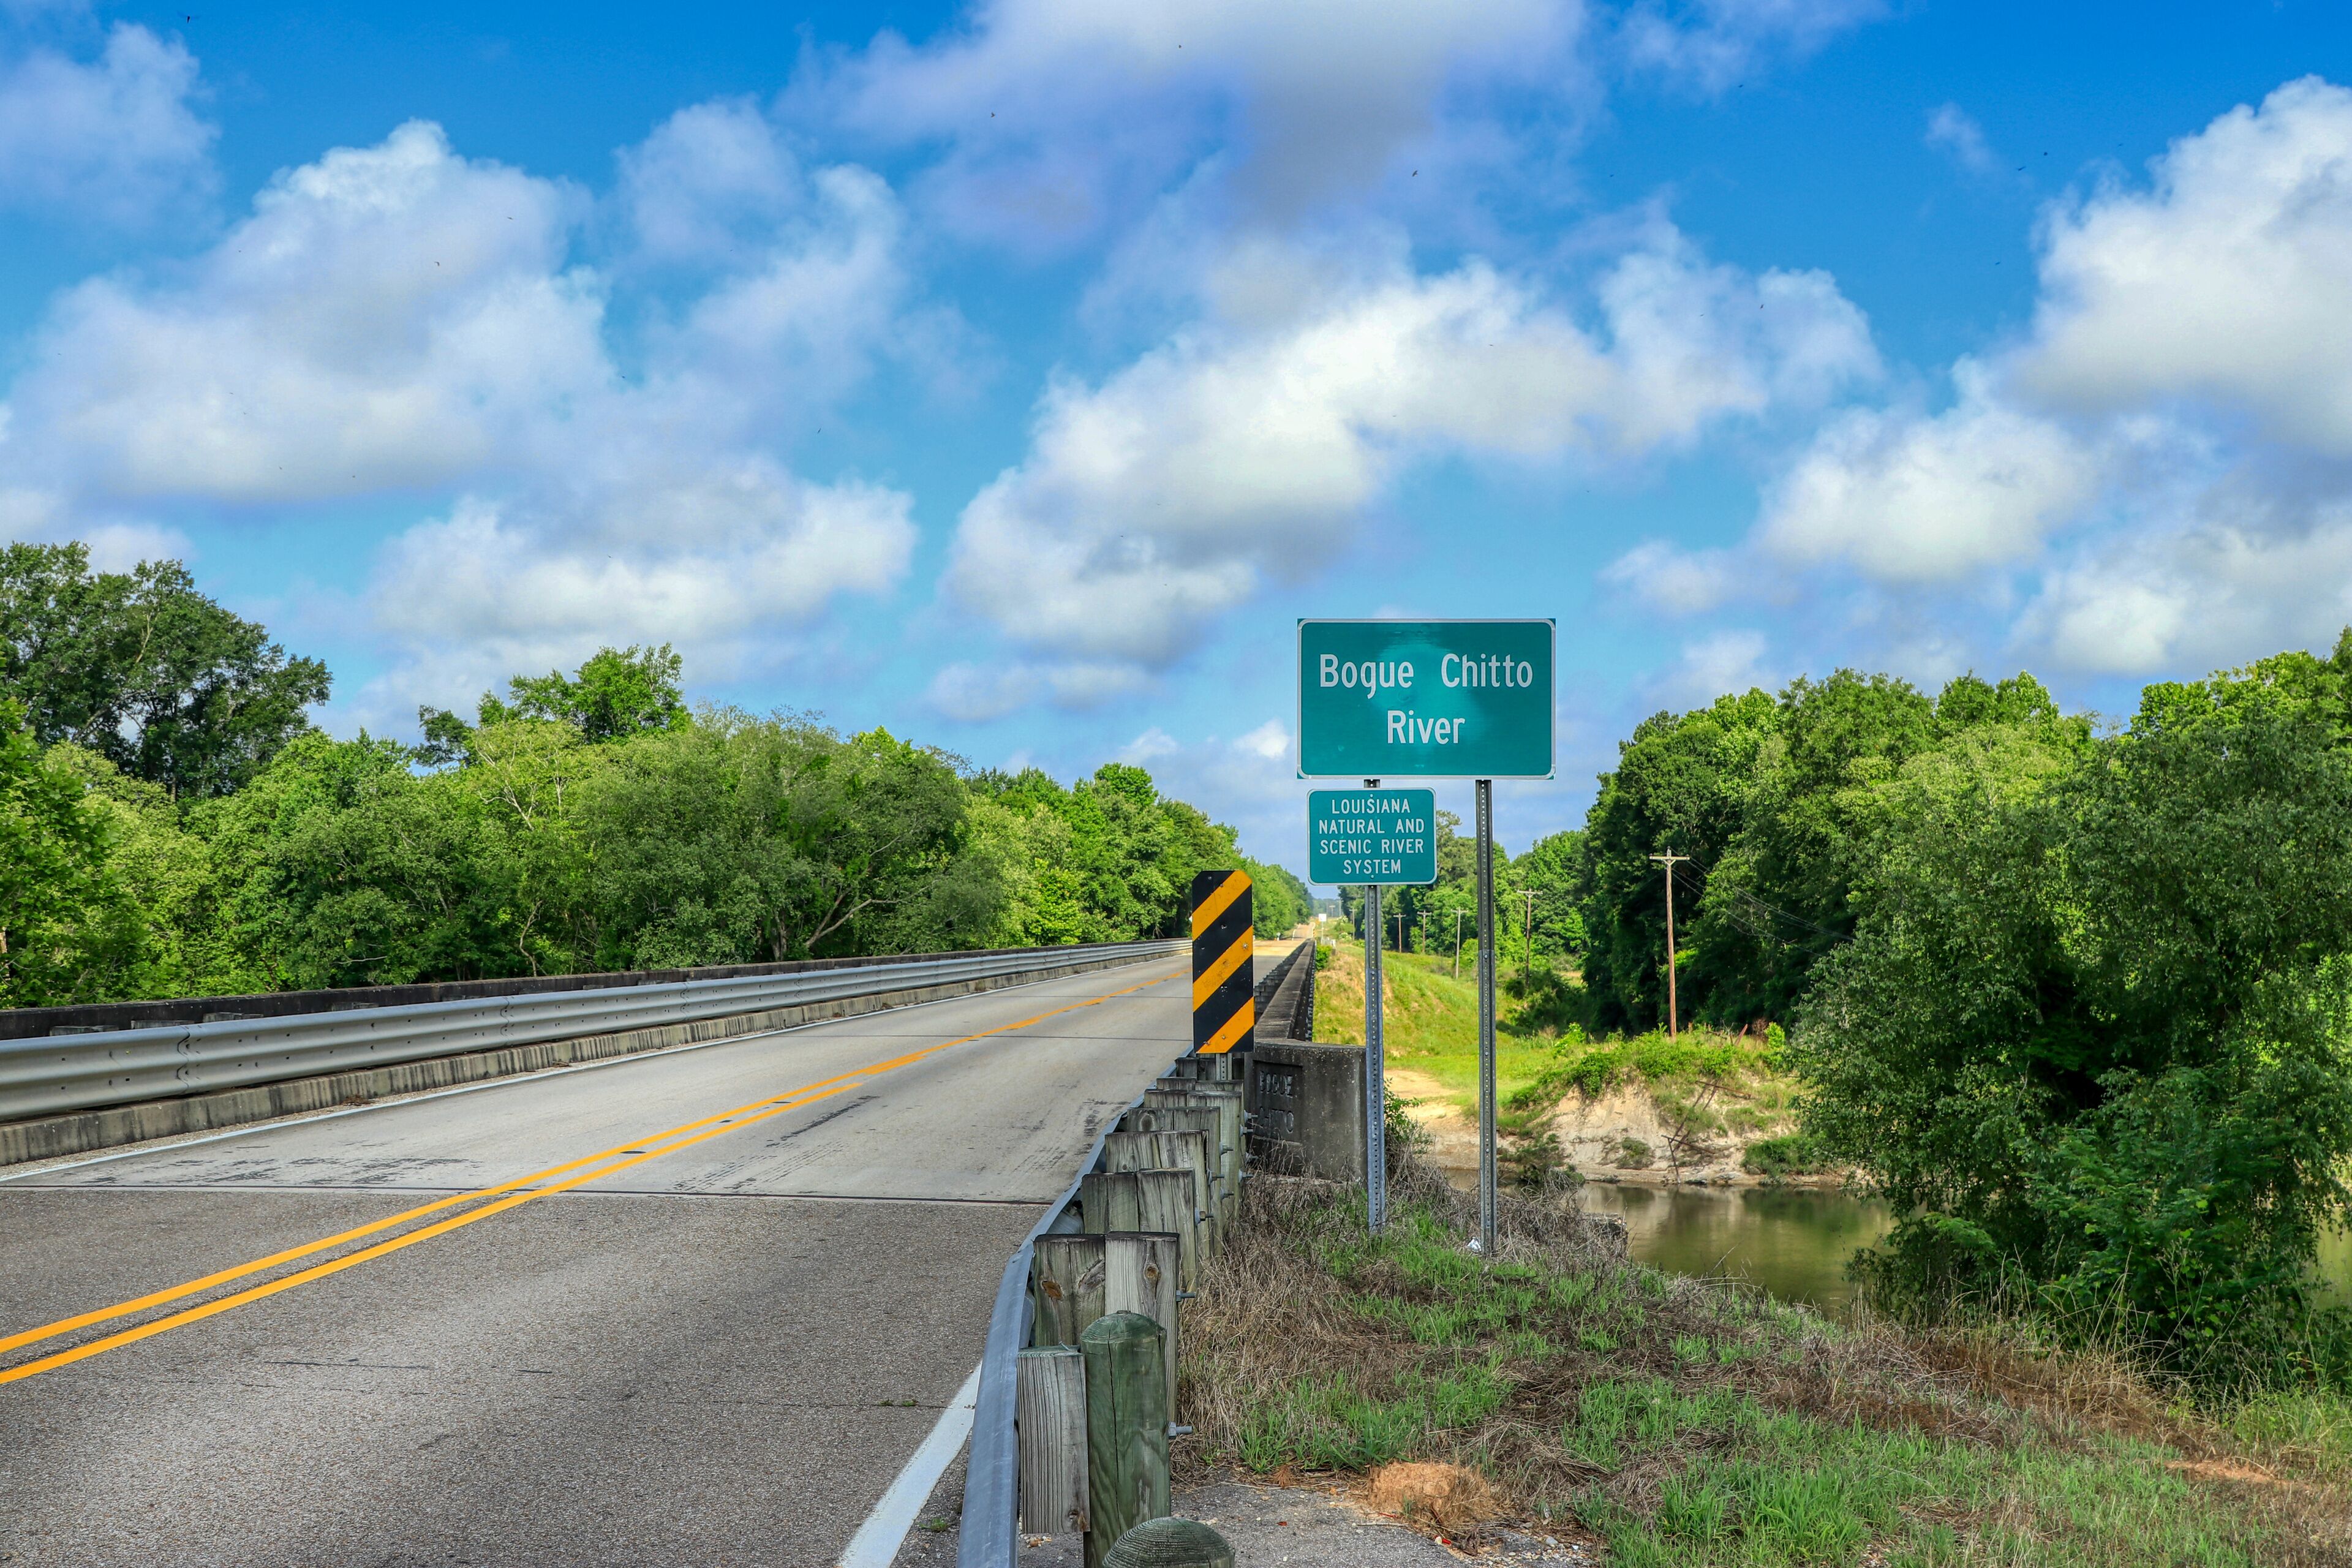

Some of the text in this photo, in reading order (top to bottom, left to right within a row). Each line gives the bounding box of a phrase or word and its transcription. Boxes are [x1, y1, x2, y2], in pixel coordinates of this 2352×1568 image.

[1320, 654, 1534, 699] Bogue Chitto
[1387, 710, 1466, 744] River
[1332, 798, 1411, 814] LOUISIANA
[1319, 818, 1425, 834] NATURAL AND
[1319, 839, 1424, 855] SCENIC RIVER
[1343, 859, 1401, 875] SYSTEM
